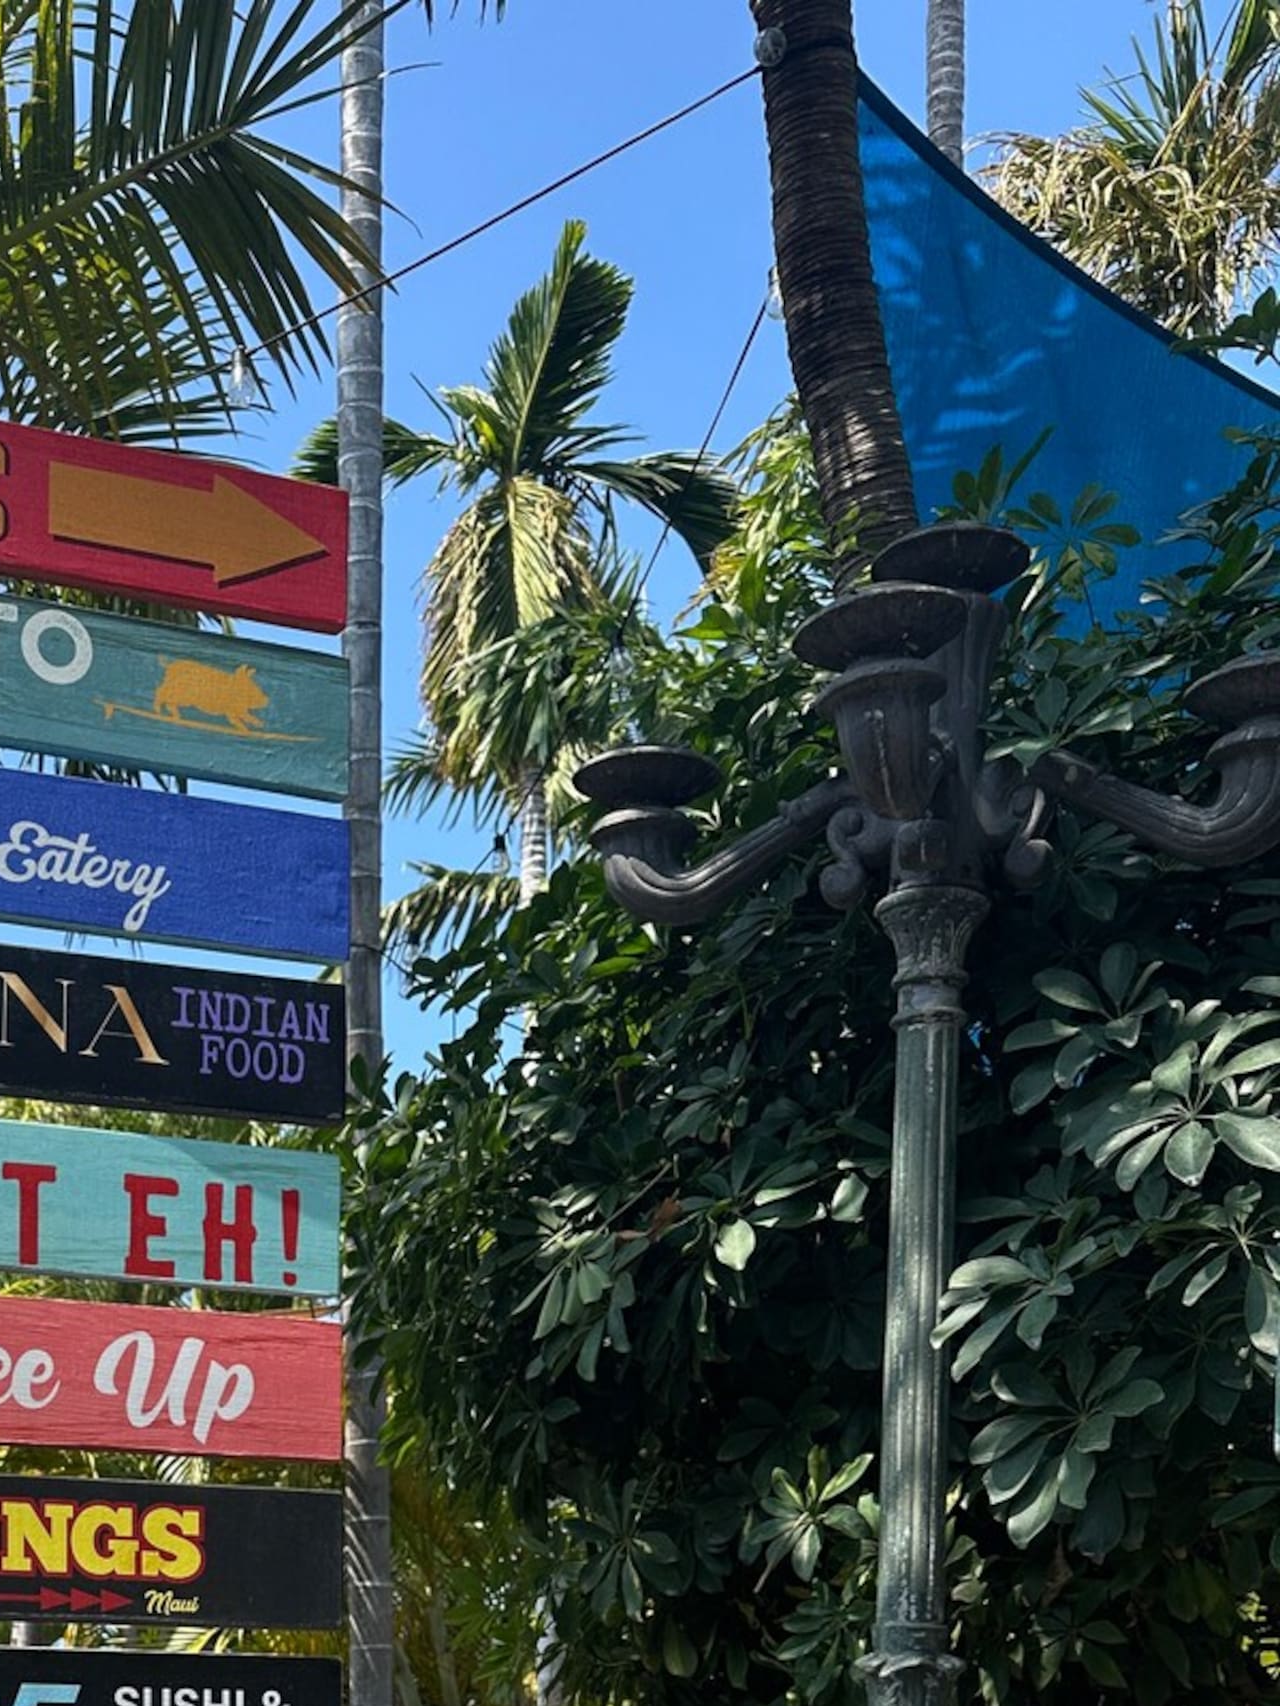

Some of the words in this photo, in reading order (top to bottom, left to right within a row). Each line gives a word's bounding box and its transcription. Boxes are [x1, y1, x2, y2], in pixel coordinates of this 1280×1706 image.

[170, 984, 332, 1044] INDIAN
[198, 1034, 308, 1085] FOOD
[122, 1171, 302, 1288] EH!
[92, 1330, 256, 1444] Up
[143, 1588, 201, 1616] Maui
